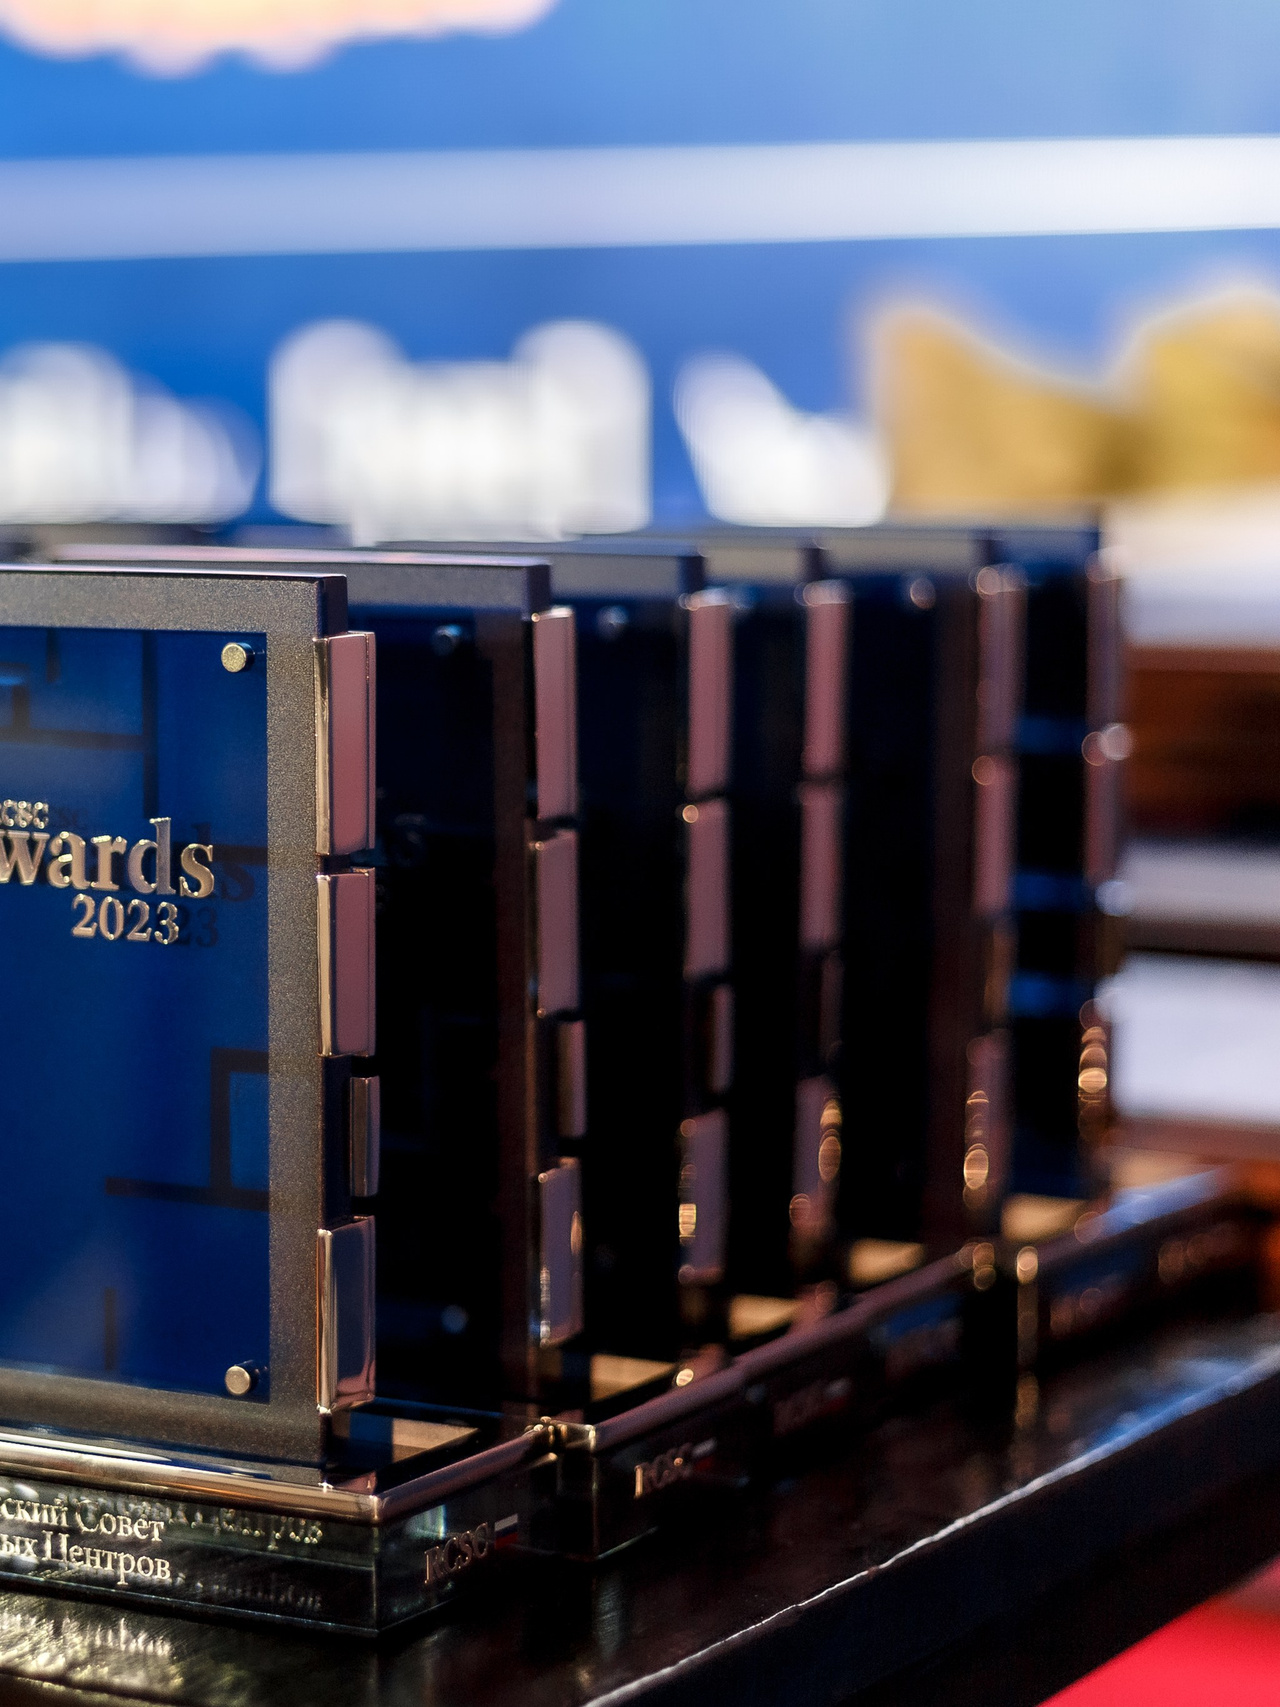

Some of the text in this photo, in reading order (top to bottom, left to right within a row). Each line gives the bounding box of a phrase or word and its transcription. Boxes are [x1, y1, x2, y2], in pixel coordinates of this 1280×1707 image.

[73, 893, 179, 945] 2023
[75, 1499, 164, 1542] Совет
[42, 1530, 171, 1585] Центров
